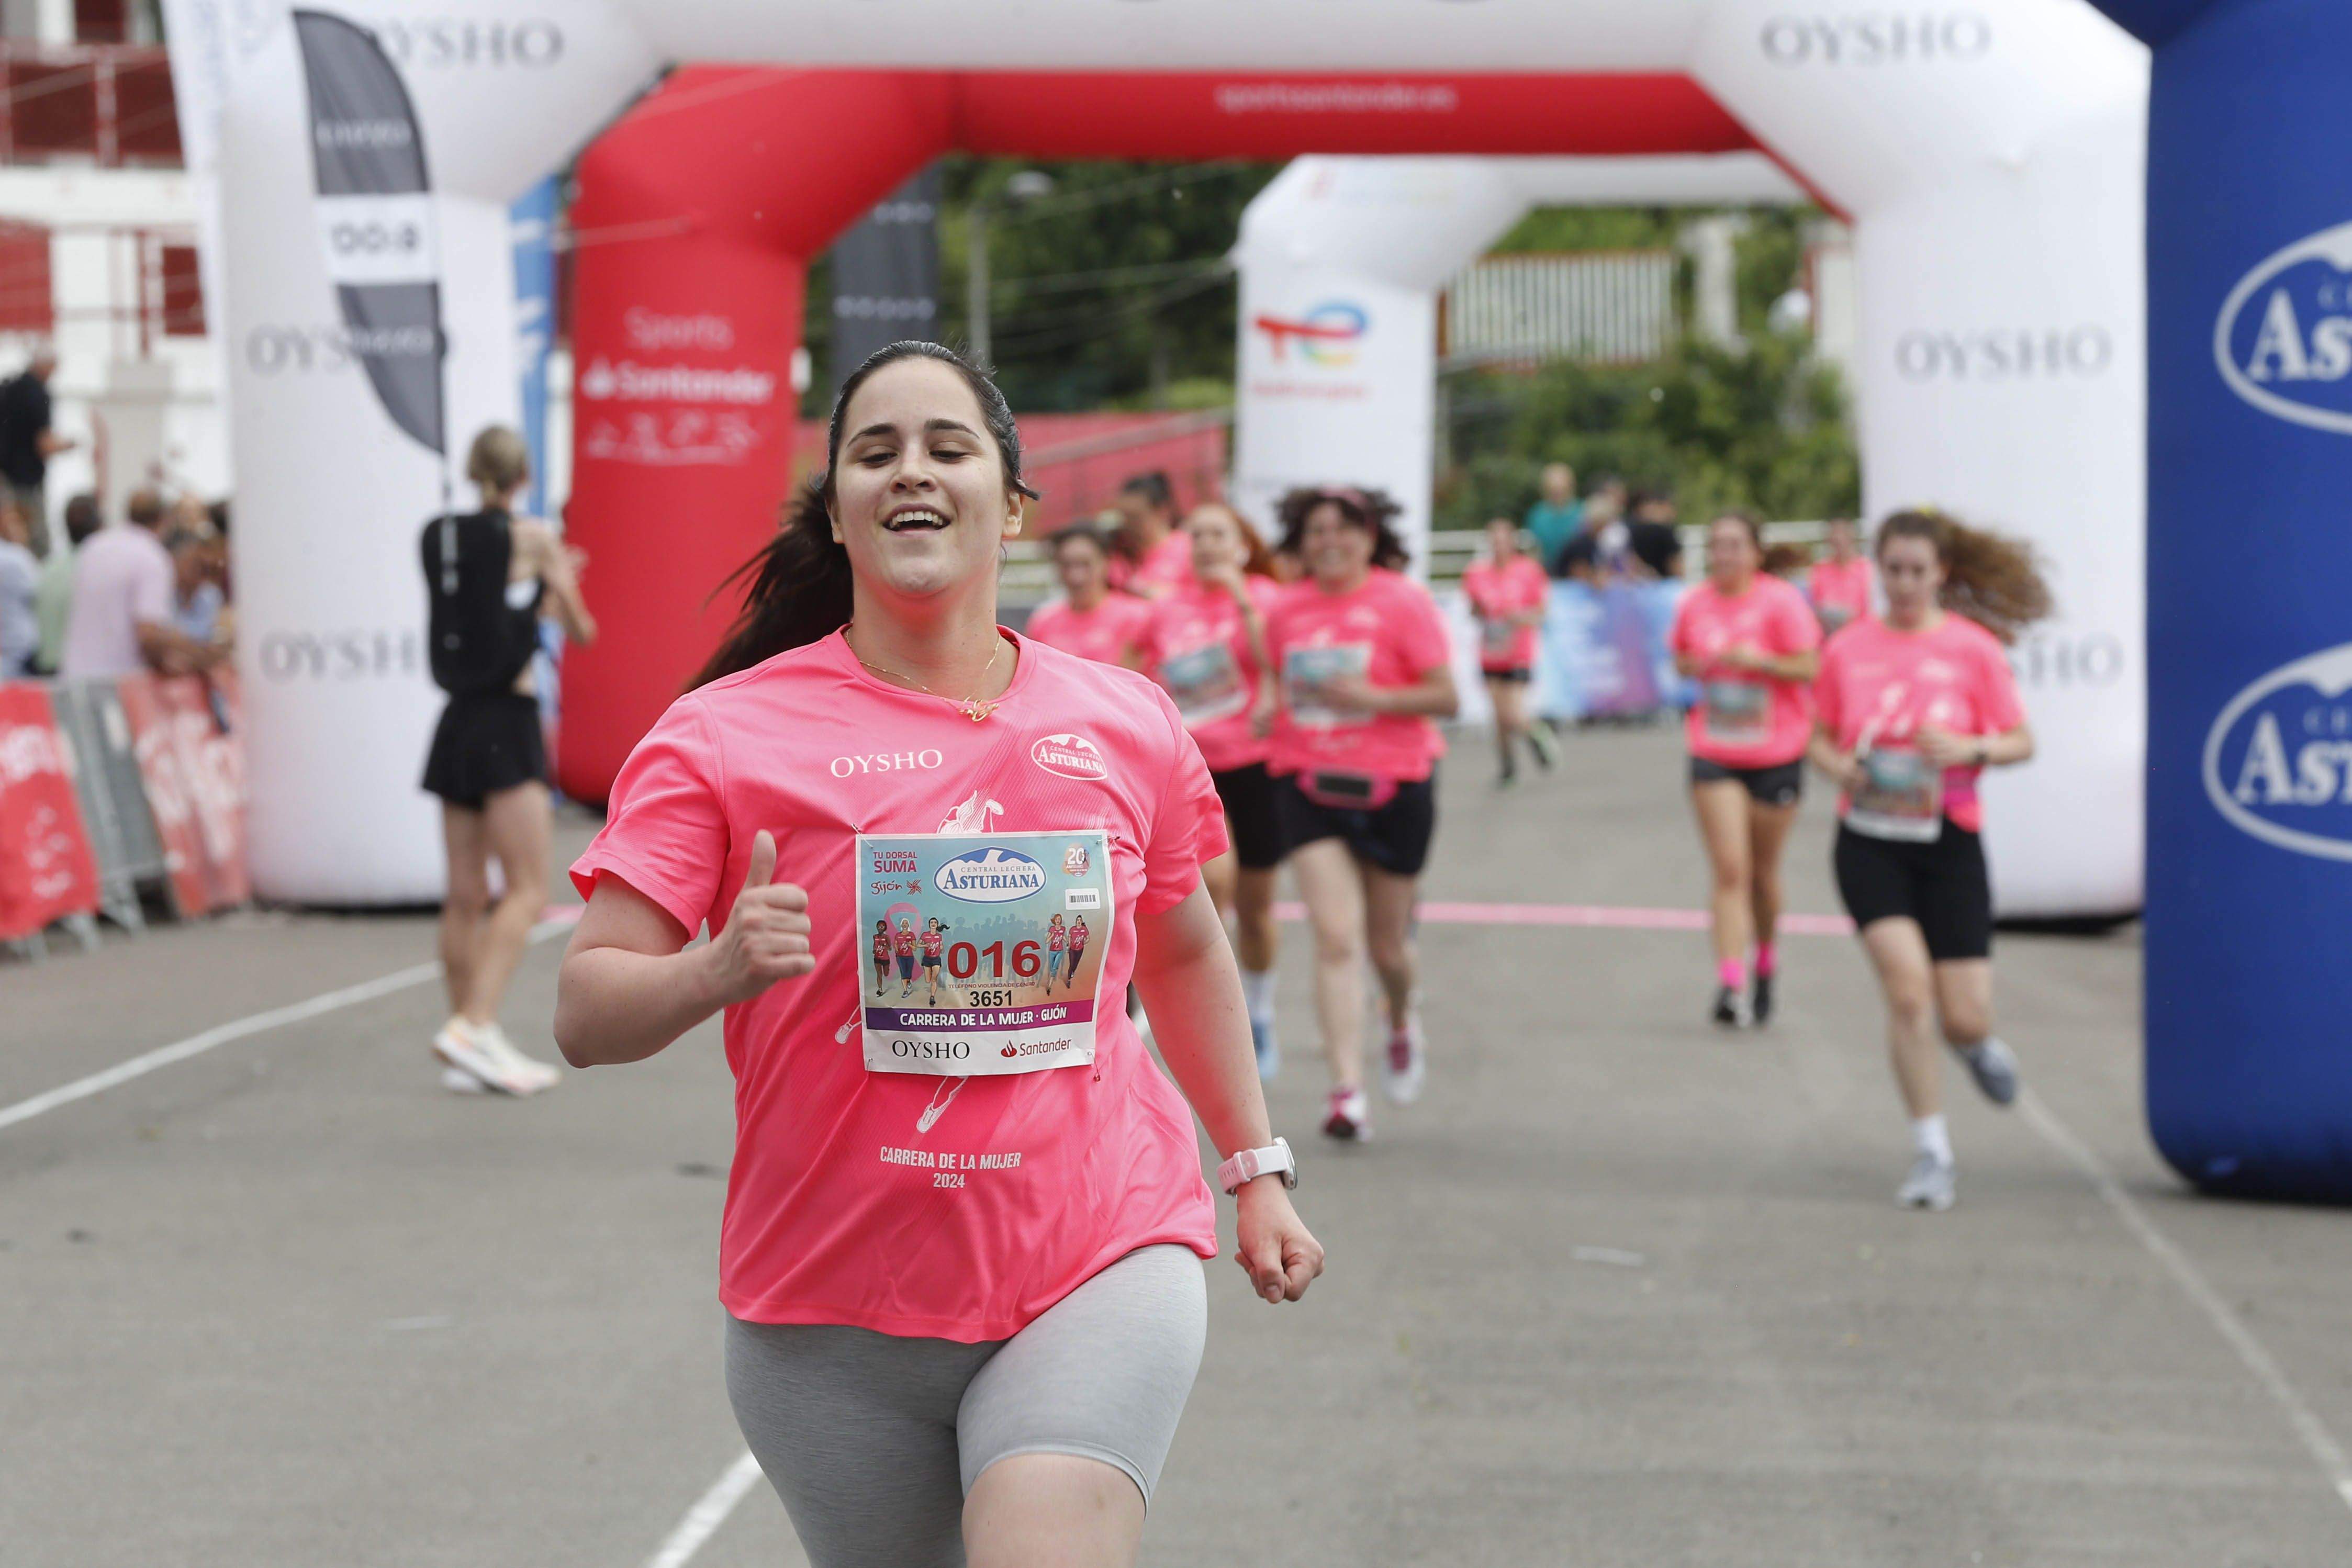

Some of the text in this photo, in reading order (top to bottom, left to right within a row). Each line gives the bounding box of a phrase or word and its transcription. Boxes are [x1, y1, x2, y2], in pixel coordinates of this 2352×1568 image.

[1762, 14, 1990, 65] OYSHO
[1895, 327, 2111, 381] OYSHO
[615, 362, 772, 403] Santander
[260, 632, 418, 683] OYSH
[1037, 745, 1105, 774] ASTURIANA
[1050, 745, 1076, 755] CENTRAL
[831, 749, 943, 778] OYSHO
[874, 860, 916, 873] SUMA
[1068, 847, 1085, 865] 20
[871, 880, 903, 895] gijón
[943, 869, 1039, 889] ASTURIANA
[947, 940, 1041, 979] 016
[970, 990, 1012, 1007] 3651
[900, 1004, 1067, 1026] CARRERA DE LA MUJER GIJÓN
[892, 1040, 970, 1059] OYSHO
[1020, 1038, 1071, 1057] Santander
[880, 1146, 1021, 1170] CARRERA DE LA MUJER
[933, 1172, 965, 1189] 2024
